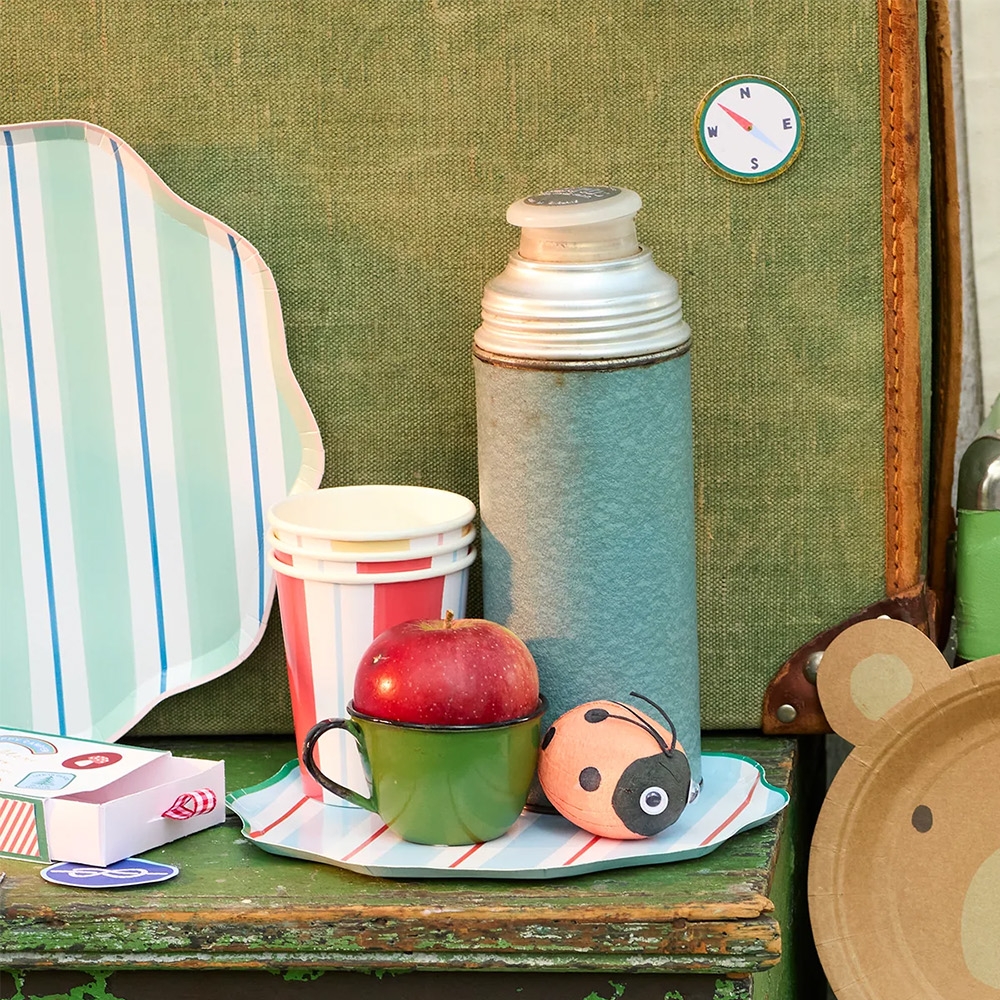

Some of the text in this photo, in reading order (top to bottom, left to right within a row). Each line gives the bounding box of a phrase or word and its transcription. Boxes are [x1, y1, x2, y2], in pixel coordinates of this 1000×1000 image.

[740, 87, 751, 99] N
[707, 118, 792, 138] W E
[750, 158, 759, 170] S
